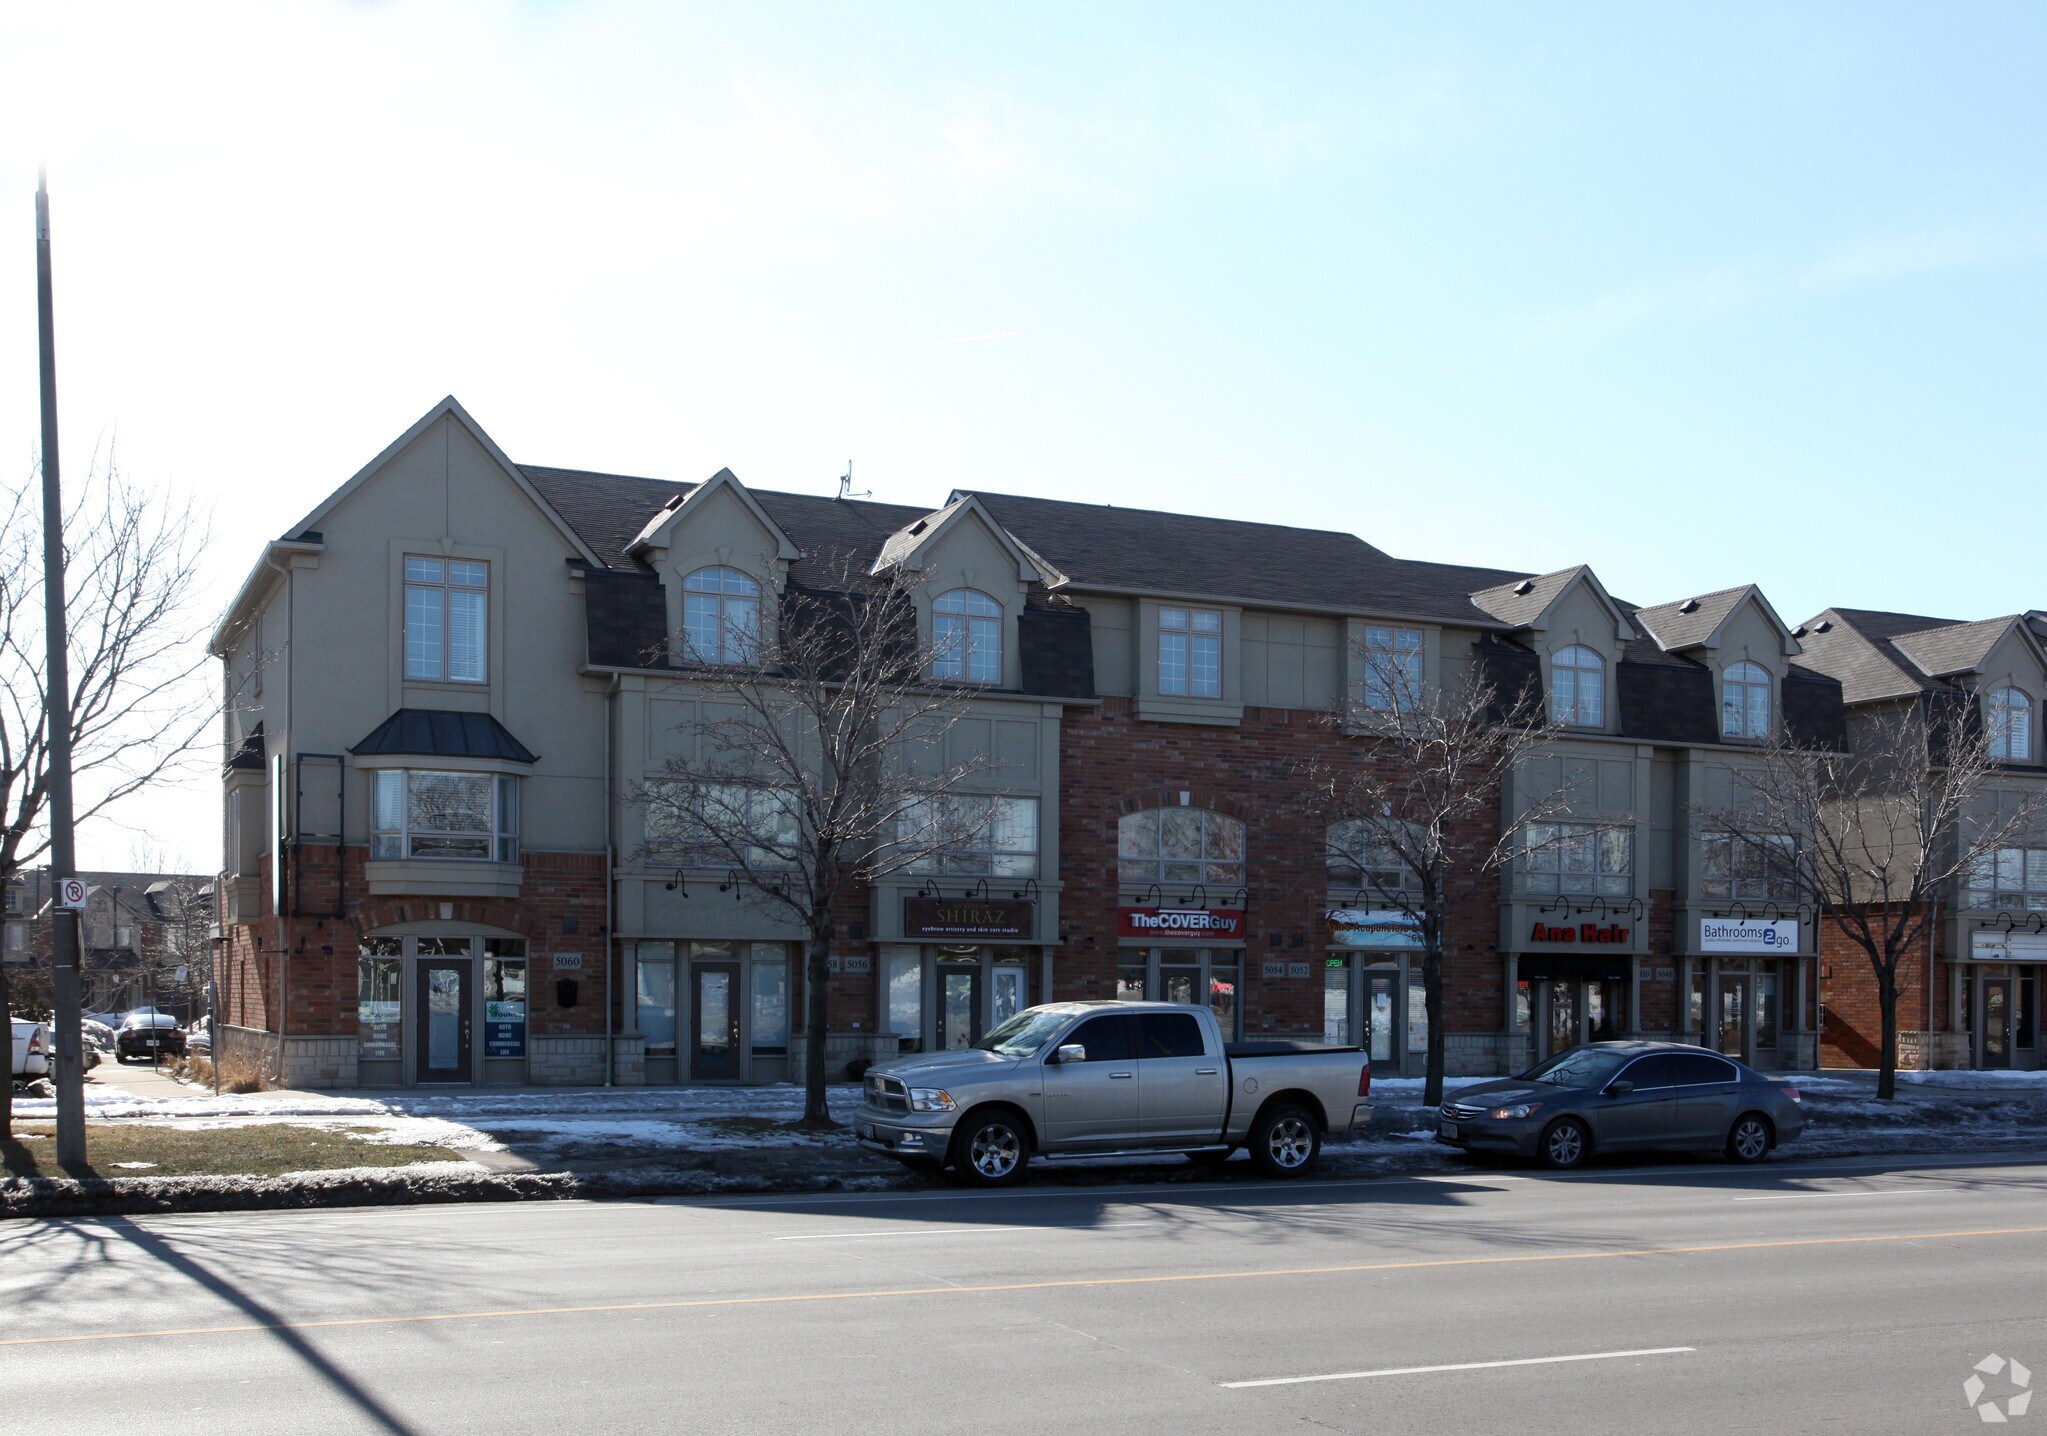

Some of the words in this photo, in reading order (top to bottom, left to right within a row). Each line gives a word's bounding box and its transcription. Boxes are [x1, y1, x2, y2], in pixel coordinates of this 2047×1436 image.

[937, 909, 1005, 924] SHIRAZ
[1131, 913, 1237, 932] TheCOVERGuy
[1532, 922, 1576, 942] Ana
[1581, 923, 1629, 943] Hair
[555, 956, 580, 966] 5060
[847, 959, 868, 969] 5056
[1264, 966, 1283, 974] 5054
[1290, 966, 1309, 975] 5052
[1657, 968, 1673, 977] 5048
